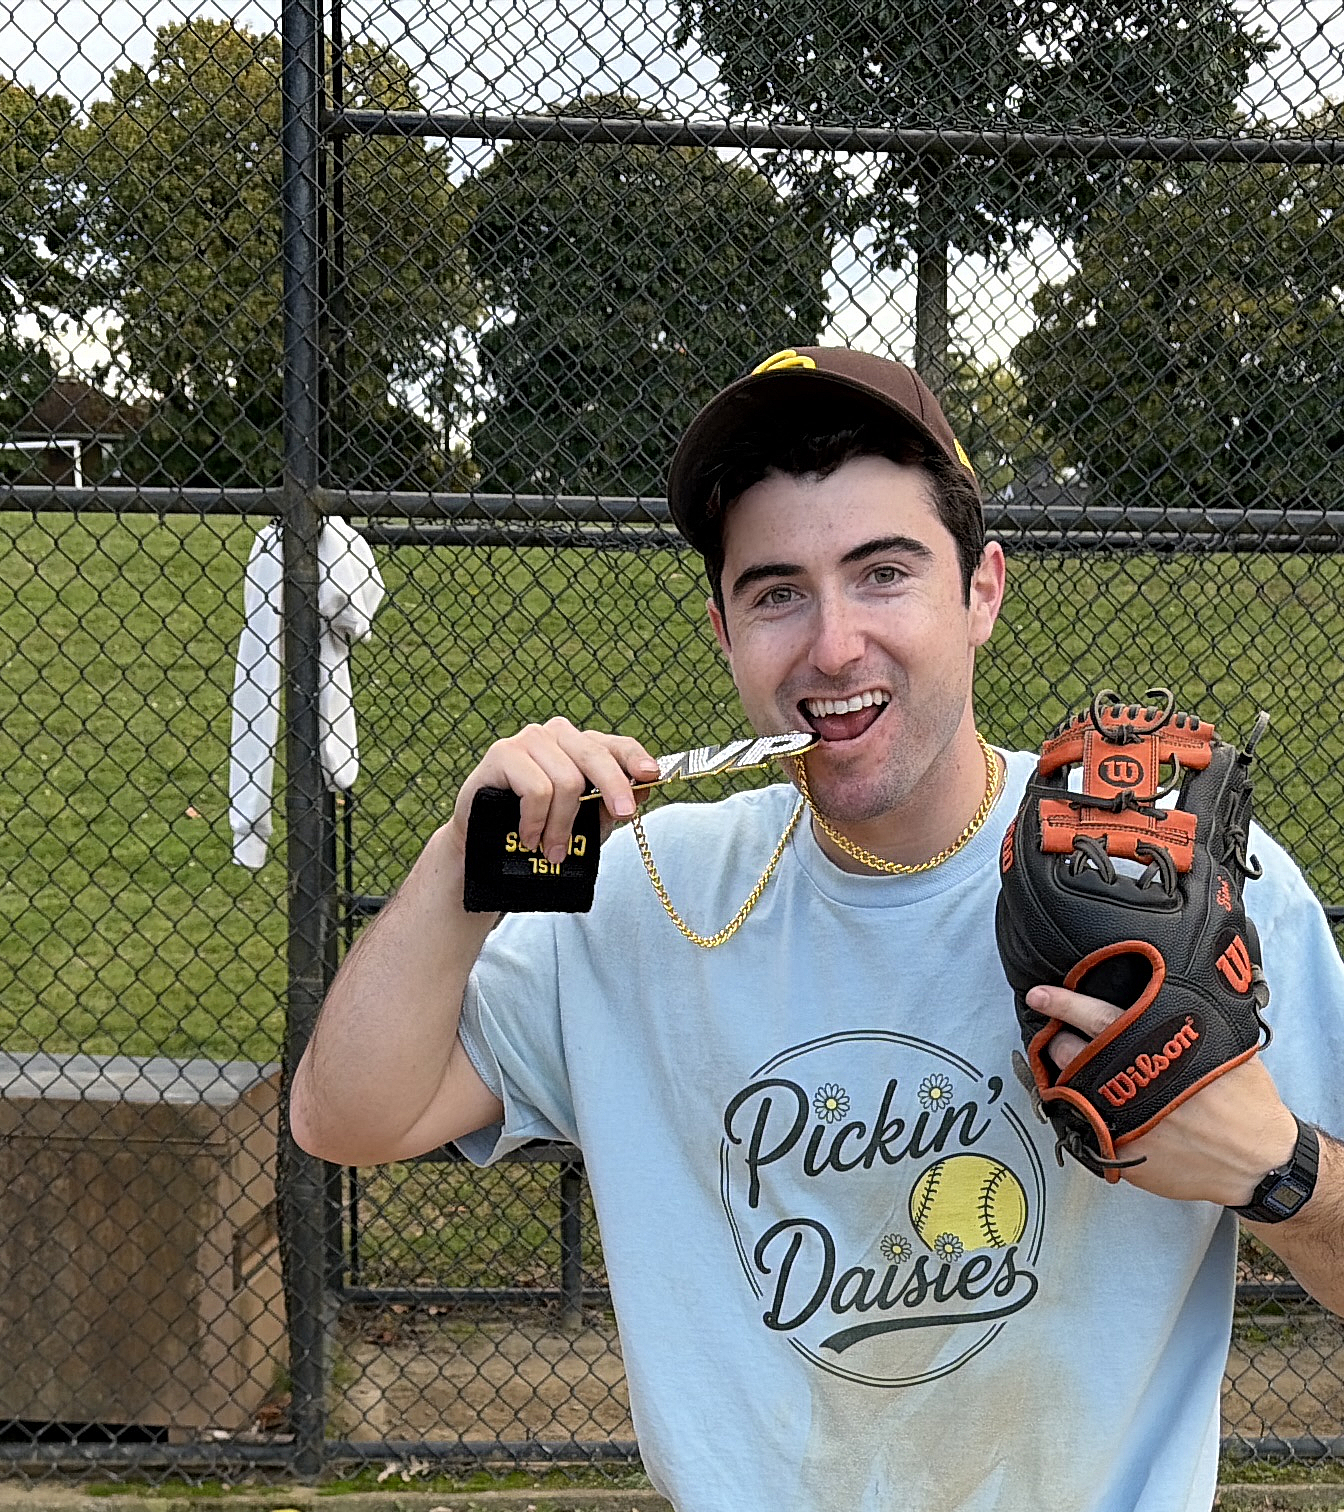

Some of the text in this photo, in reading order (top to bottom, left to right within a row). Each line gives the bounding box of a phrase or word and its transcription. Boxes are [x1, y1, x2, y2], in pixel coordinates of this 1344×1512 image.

[1097, 1022, 1200, 1107] Wilson
[724, 1075, 1004, 1209] Pickin'
[754, 1218, 1038, 1332] Daisies
